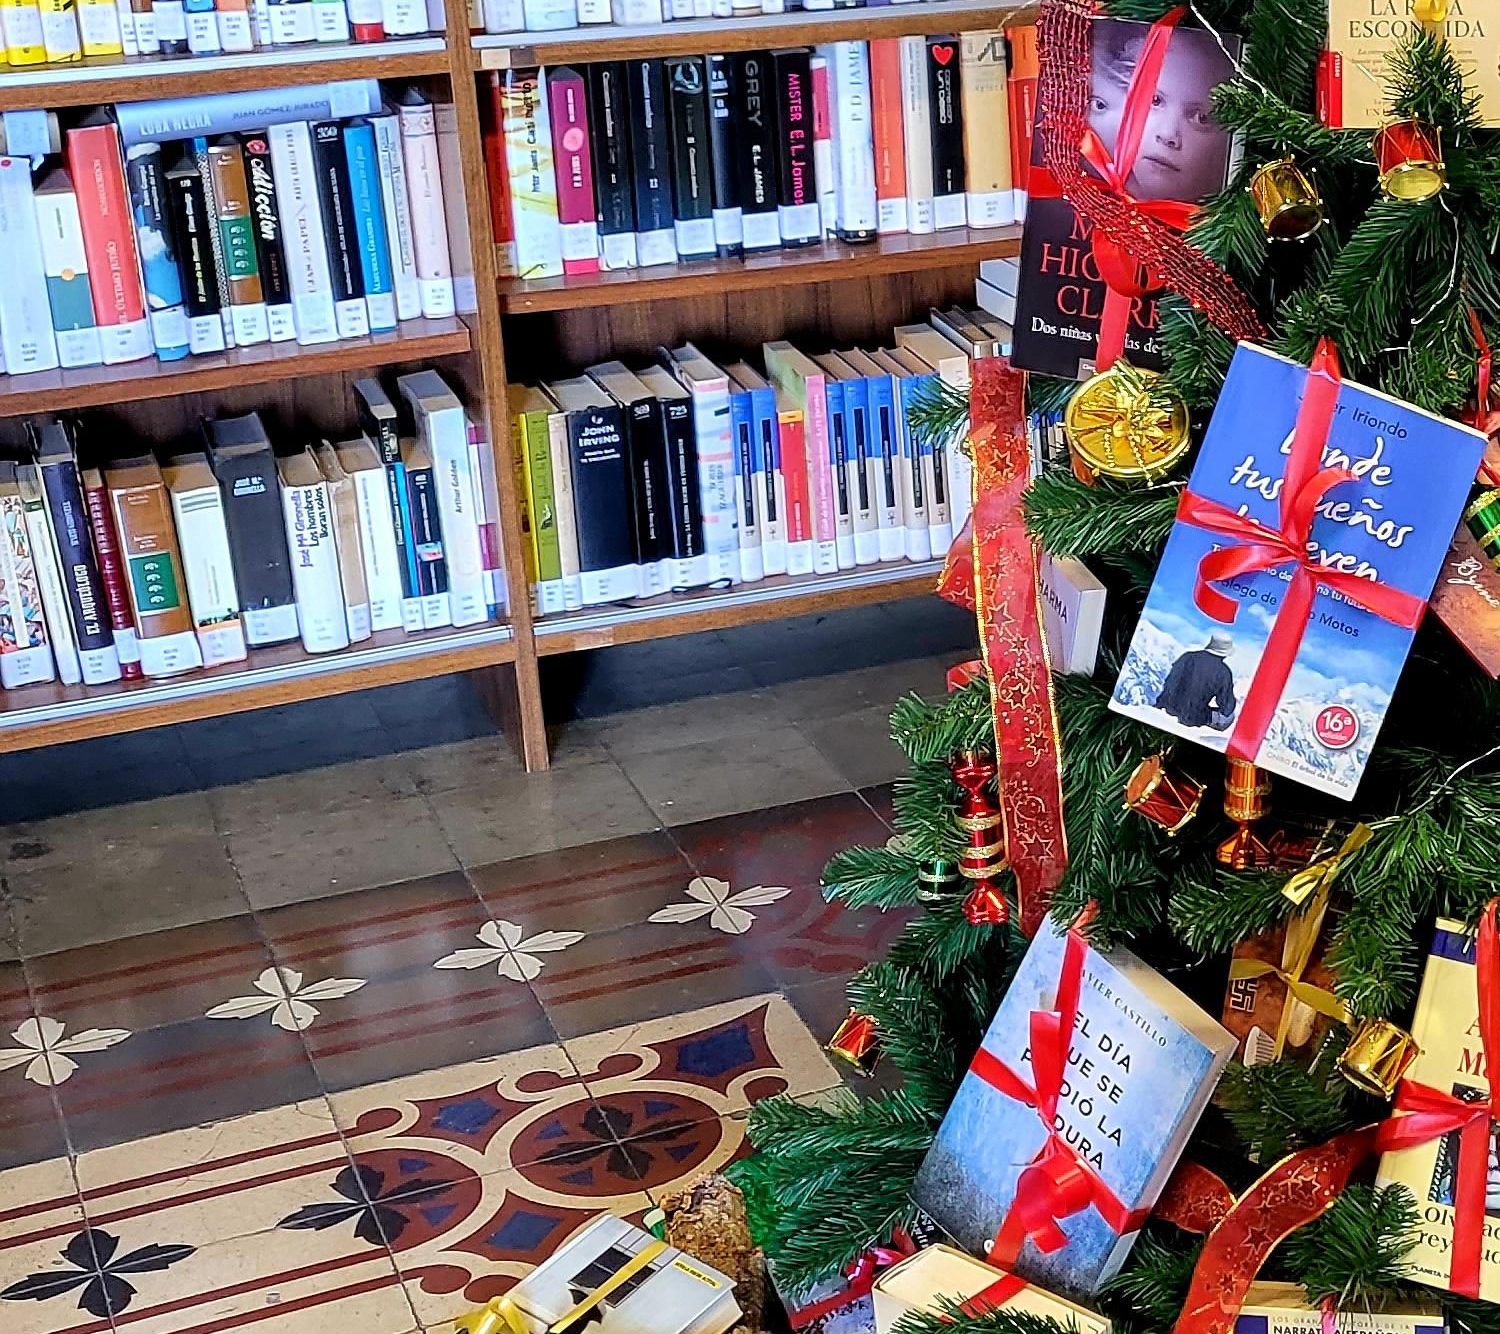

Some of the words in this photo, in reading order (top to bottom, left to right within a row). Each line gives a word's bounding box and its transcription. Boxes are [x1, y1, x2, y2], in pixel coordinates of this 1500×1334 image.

[744, 60, 763, 127] GREY
[788, 73, 802, 121] MISTER
[753, 167, 765, 204] JAMES
[1032, 316, 1057, 335] Dos
[1059, 322, 1091, 342] niñas
[578, 433, 621, 448] IRVING
[582, 423, 616, 436] JOHN
[1351, 405, 1408, 441] Iriondo
[1231, 457, 1286, 501] tus
[304, 490, 317, 531] hombres
[1314, 498, 1415, 548] ueños
[75, 564, 97, 621] ARQUEÓLOGO
[87, 623, 99, 635] EL
[1319, 610, 1360, 638] Motos
[1113, 993, 1169, 1048] CASTILLO
[1098, 1032, 1132, 1074] DÍA
[1066, 1052, 1096, 1080] UE
[1097, 1076, 1125, 1105] SE
[1097, 1115, 1124, 1148] LA
[1418, 1230, 1453, 1254] rey
